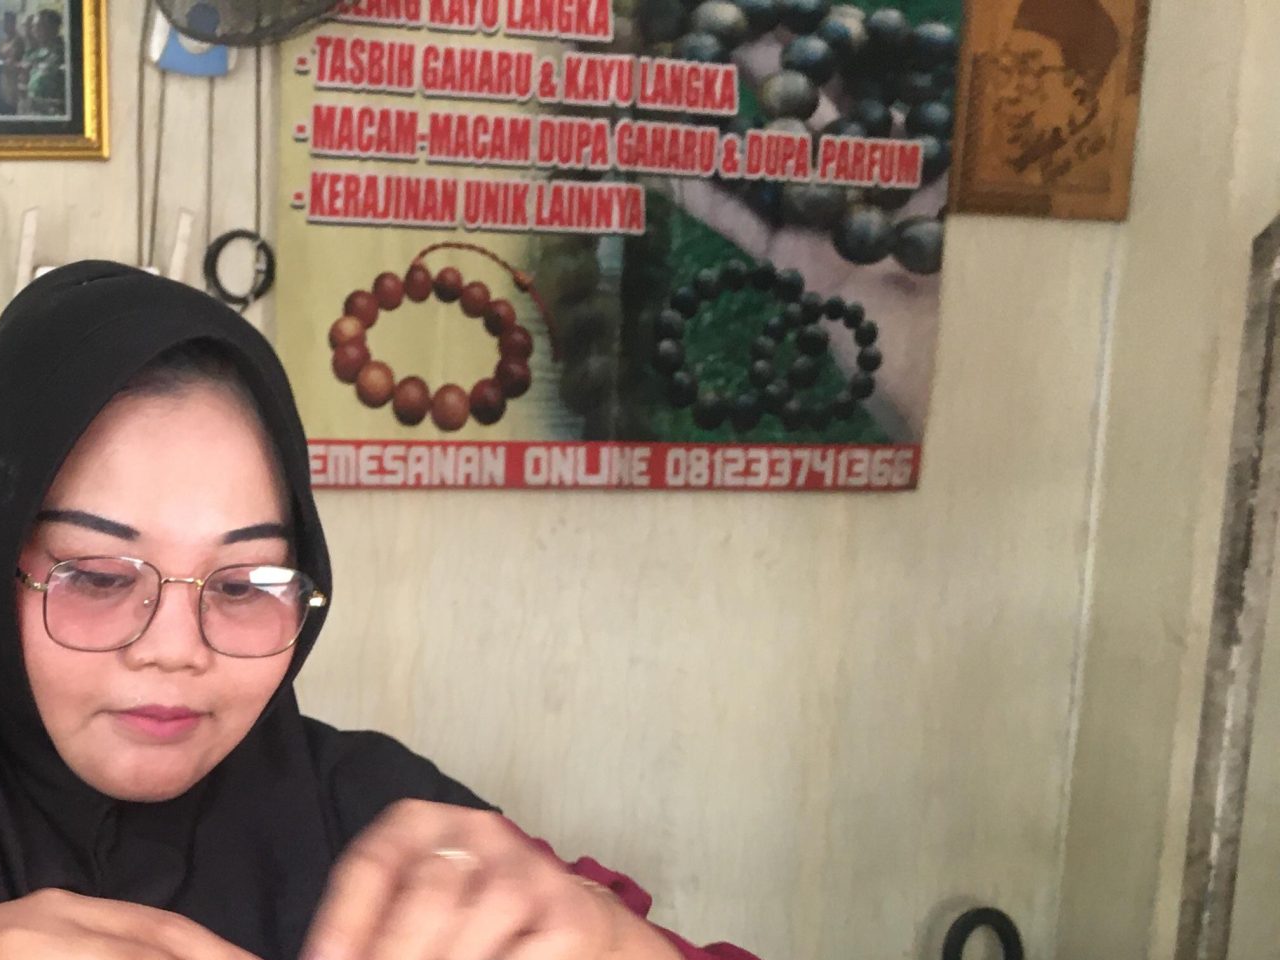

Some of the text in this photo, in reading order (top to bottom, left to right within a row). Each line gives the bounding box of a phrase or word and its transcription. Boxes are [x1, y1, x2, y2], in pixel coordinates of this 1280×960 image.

[315, 35, 736, 111] TASBIH GAHARU & KAYU LANGKA
[311, 104, 921, 185] MACAM-MACAM DUPA GAHARU & DUPA PARFUM
[308, 171, 642, 231] KERAJINAN UNIK LAINNYA
[307, 444, 507, 486] EMESANAN
[523, 446, 651, 486] ONLINE
